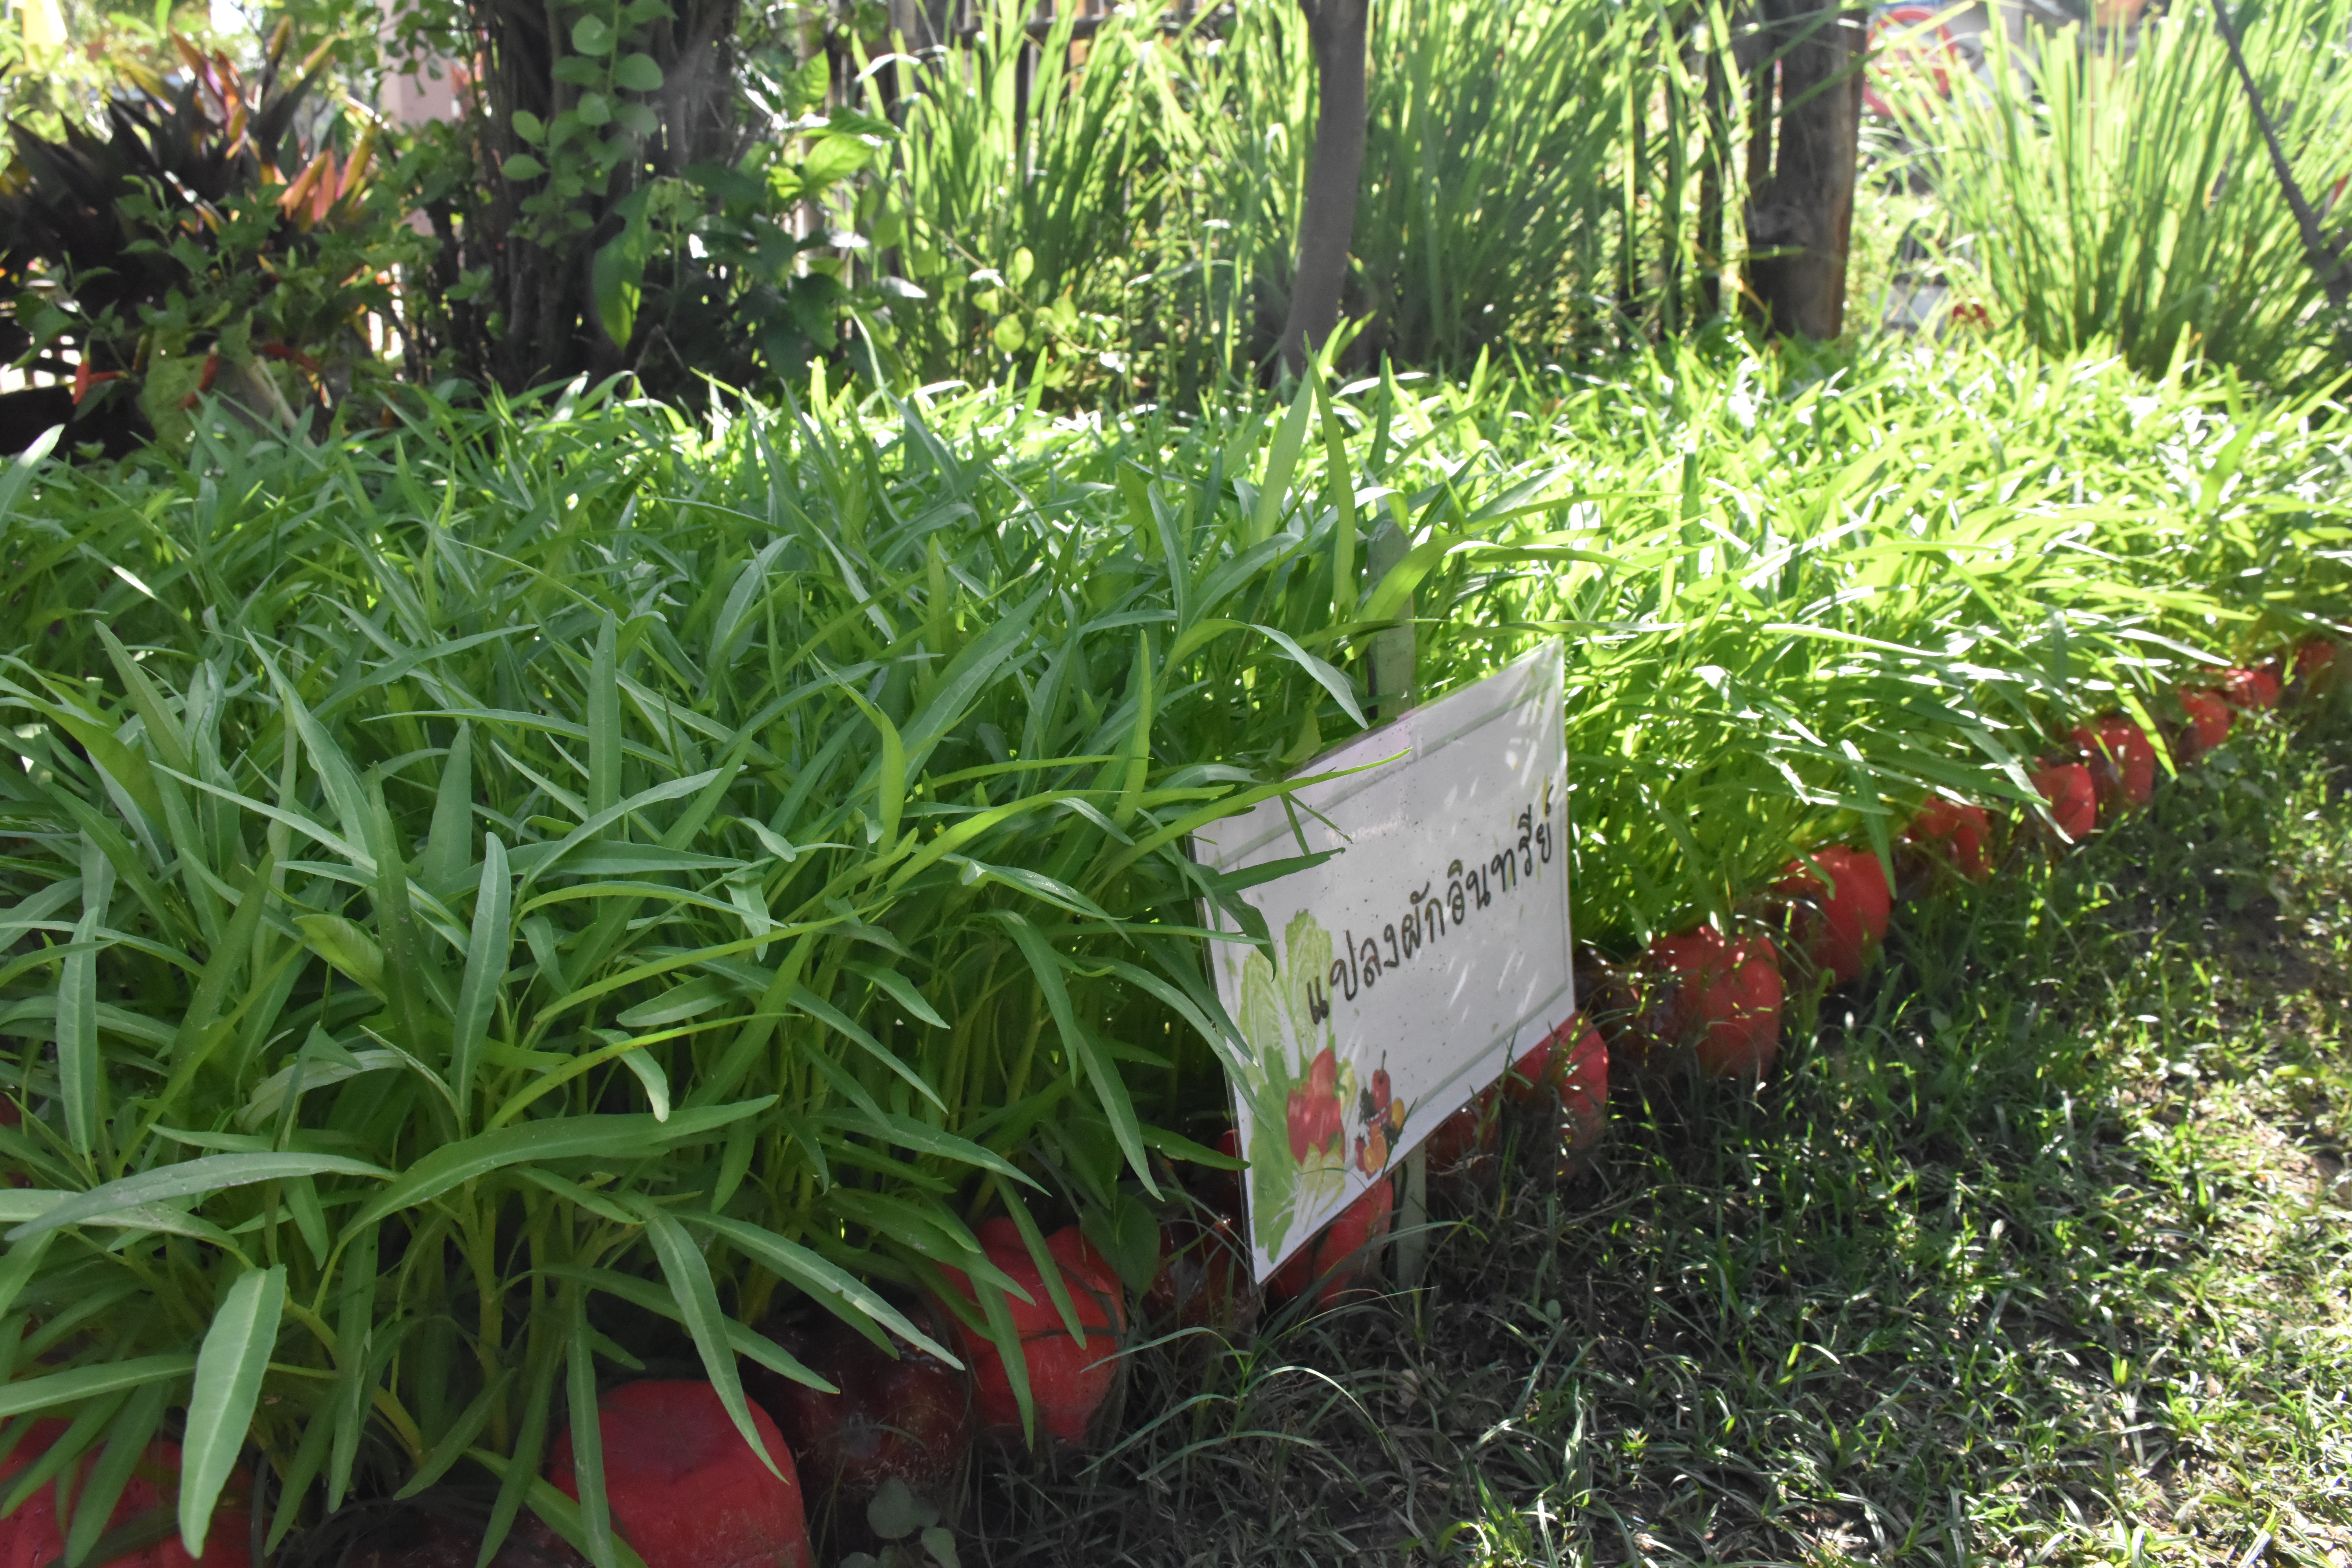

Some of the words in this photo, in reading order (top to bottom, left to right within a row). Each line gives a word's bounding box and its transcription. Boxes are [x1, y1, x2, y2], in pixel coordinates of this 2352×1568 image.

[1307, 785, 1553, 1024] แปลงผักอินทรีย์
